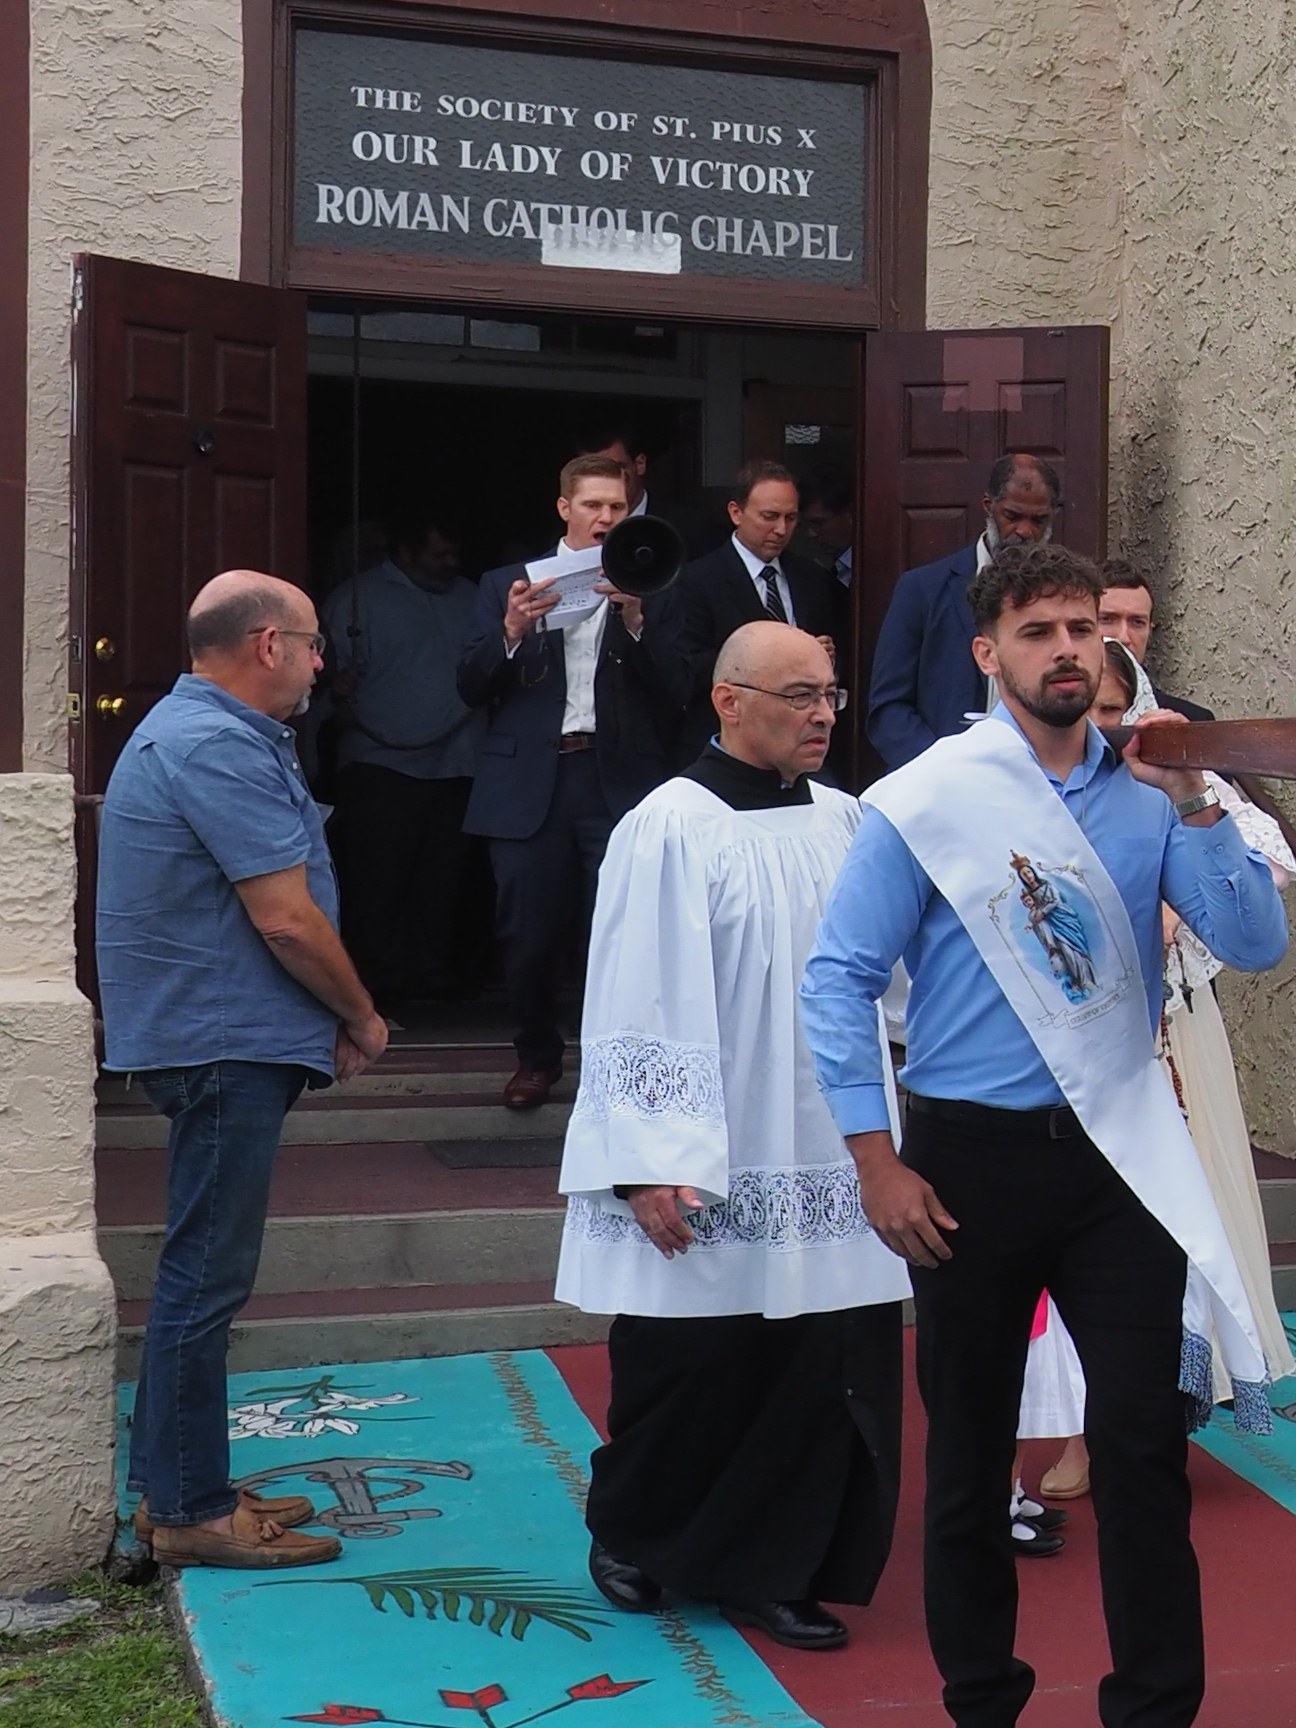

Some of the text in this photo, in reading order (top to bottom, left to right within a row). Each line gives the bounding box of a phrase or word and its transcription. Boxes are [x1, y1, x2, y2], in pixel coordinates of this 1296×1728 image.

[351, 86, 817, 149] THE SOCIETY OF ST. PIUS X
[352, 131, 815, 197] OUR LADY OF VICTORY
[315, 183, 853, 261] ROMAN CATHOLIC CHAPEL
